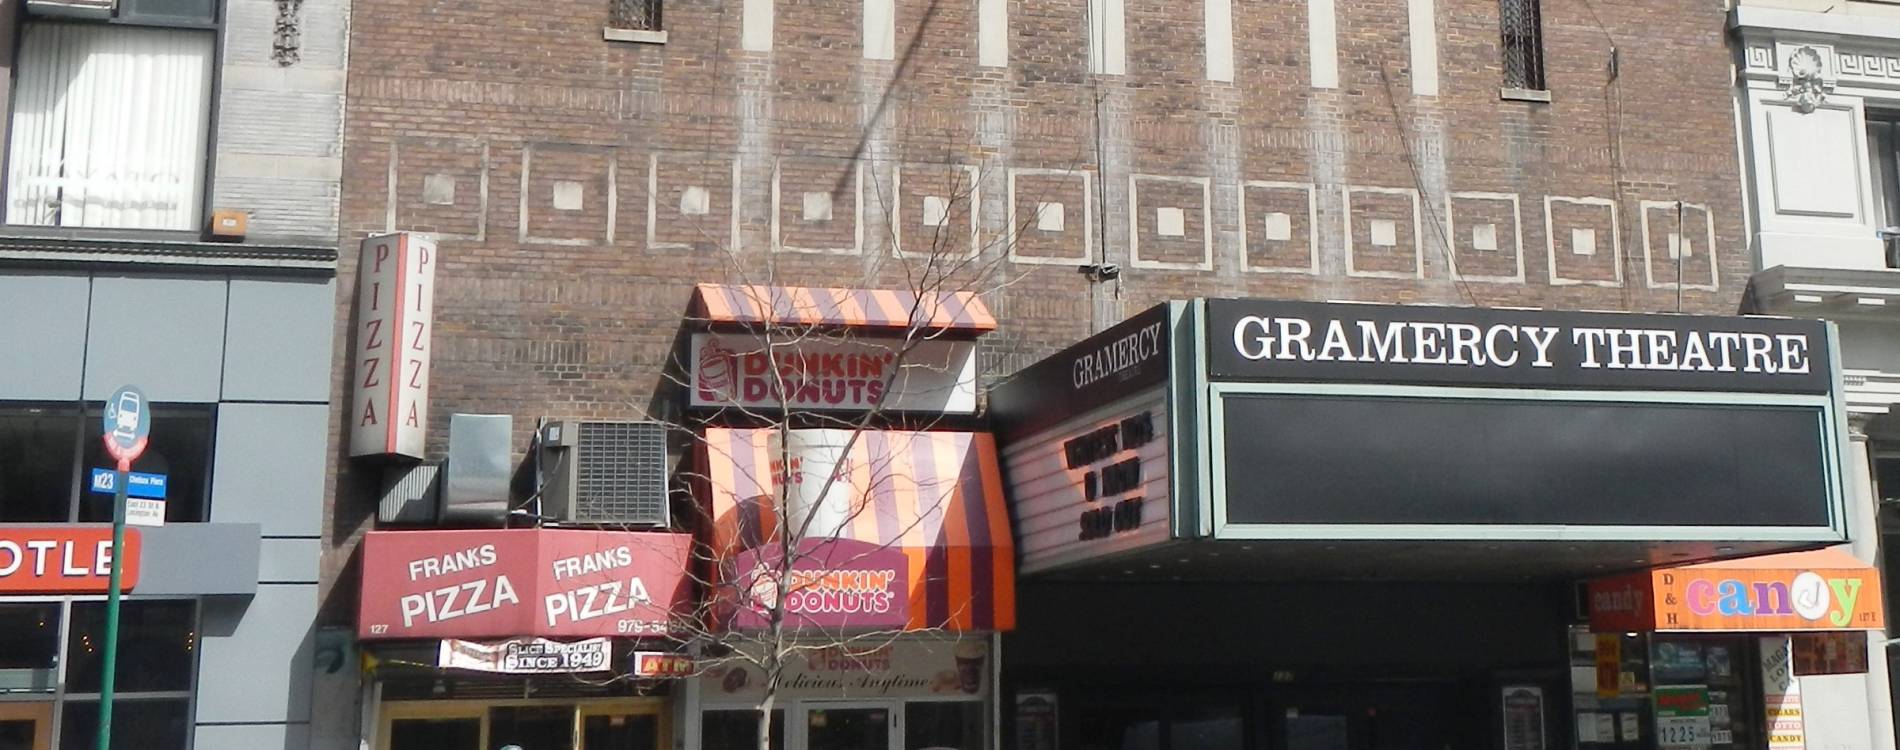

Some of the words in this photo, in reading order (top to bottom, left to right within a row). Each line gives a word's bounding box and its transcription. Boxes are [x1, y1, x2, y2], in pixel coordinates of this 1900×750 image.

[360, 243, 389, 427] PIZZA
[406, 246, 429, 428] PIZZA
[1233, 316, 1560, 369] GRAMERCY
[1573, 327, 1810, 374] THEATRE
[1073, 322, 1161, 389] GRAMERCY
[743, 377, 884, 405] DONUTS
[790, 569, 896, 592] DUNKIN'
[400, 574, 519, 628] PIZZA
[545, 576, 652, 627] PIZZA
[784, 591, 890, 613] DONUTS
[370, 624, 388, 634] 127
[505, 654, 558, 669] SINCE
[644, 657, 688, 672] ATM
